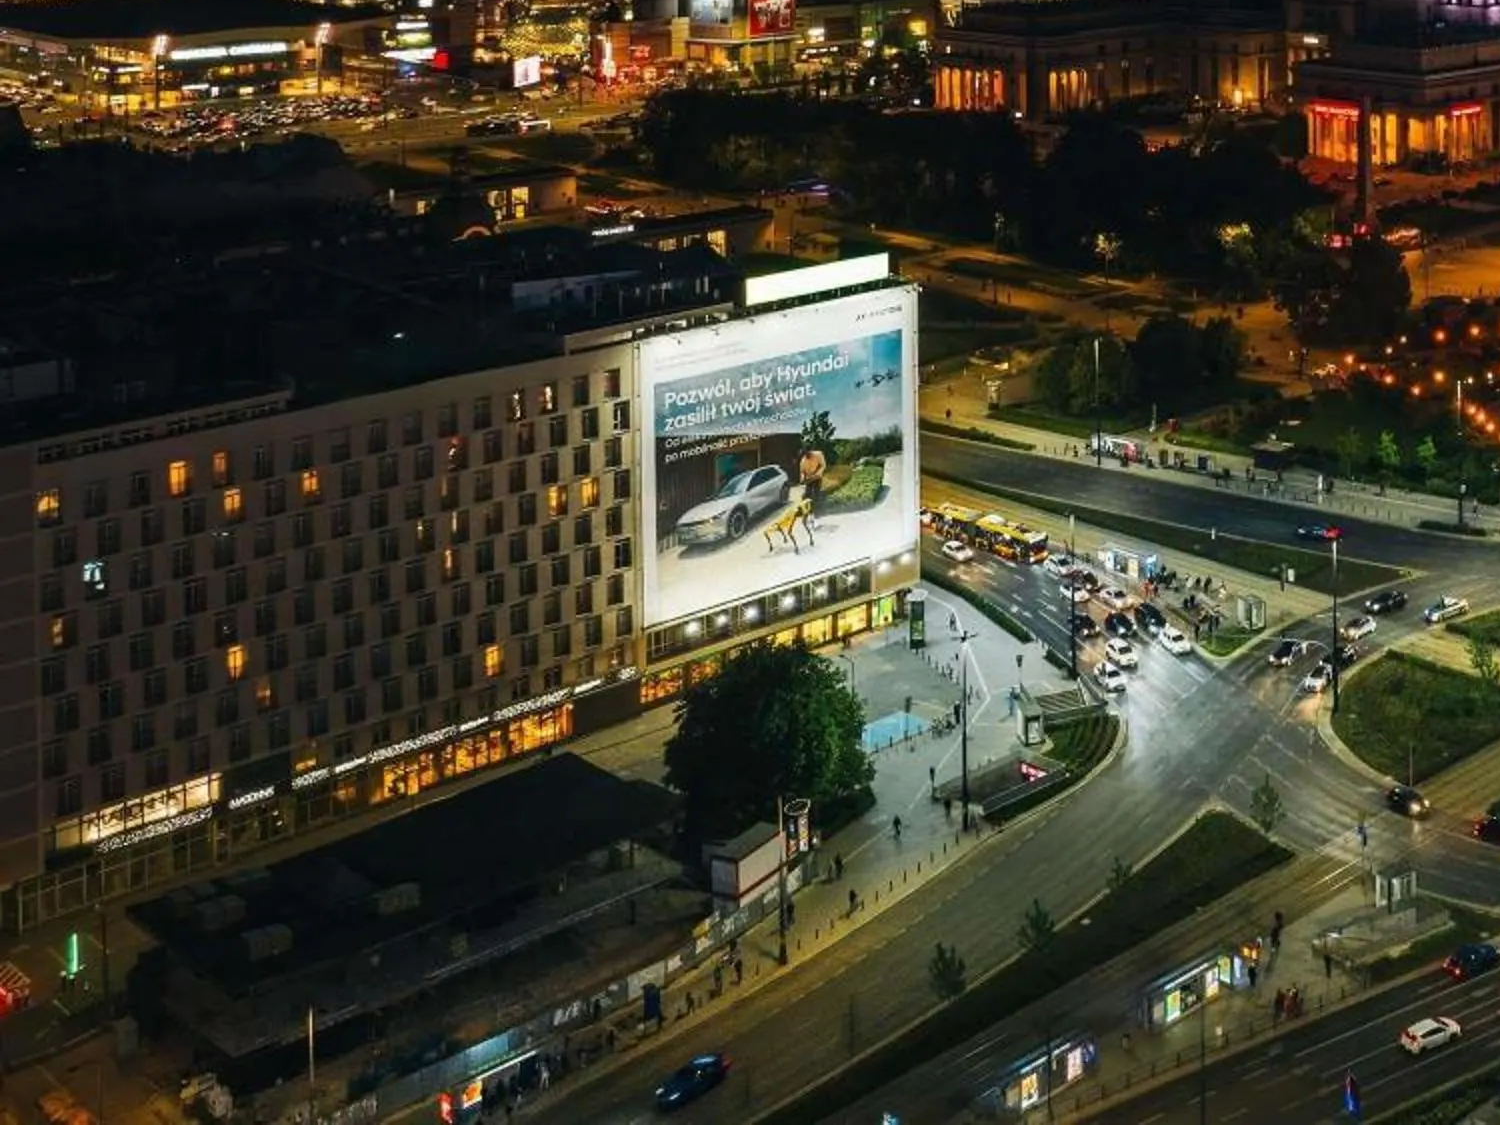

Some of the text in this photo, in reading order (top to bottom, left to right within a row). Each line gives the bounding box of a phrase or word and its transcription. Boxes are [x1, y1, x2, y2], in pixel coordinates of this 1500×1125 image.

[664, 379, 736, 409] Pozwól,
[739, 371, 773, 390] aby
[777, 354, 849, 382] Hyundai
[721, 395, 761, 413] twój
